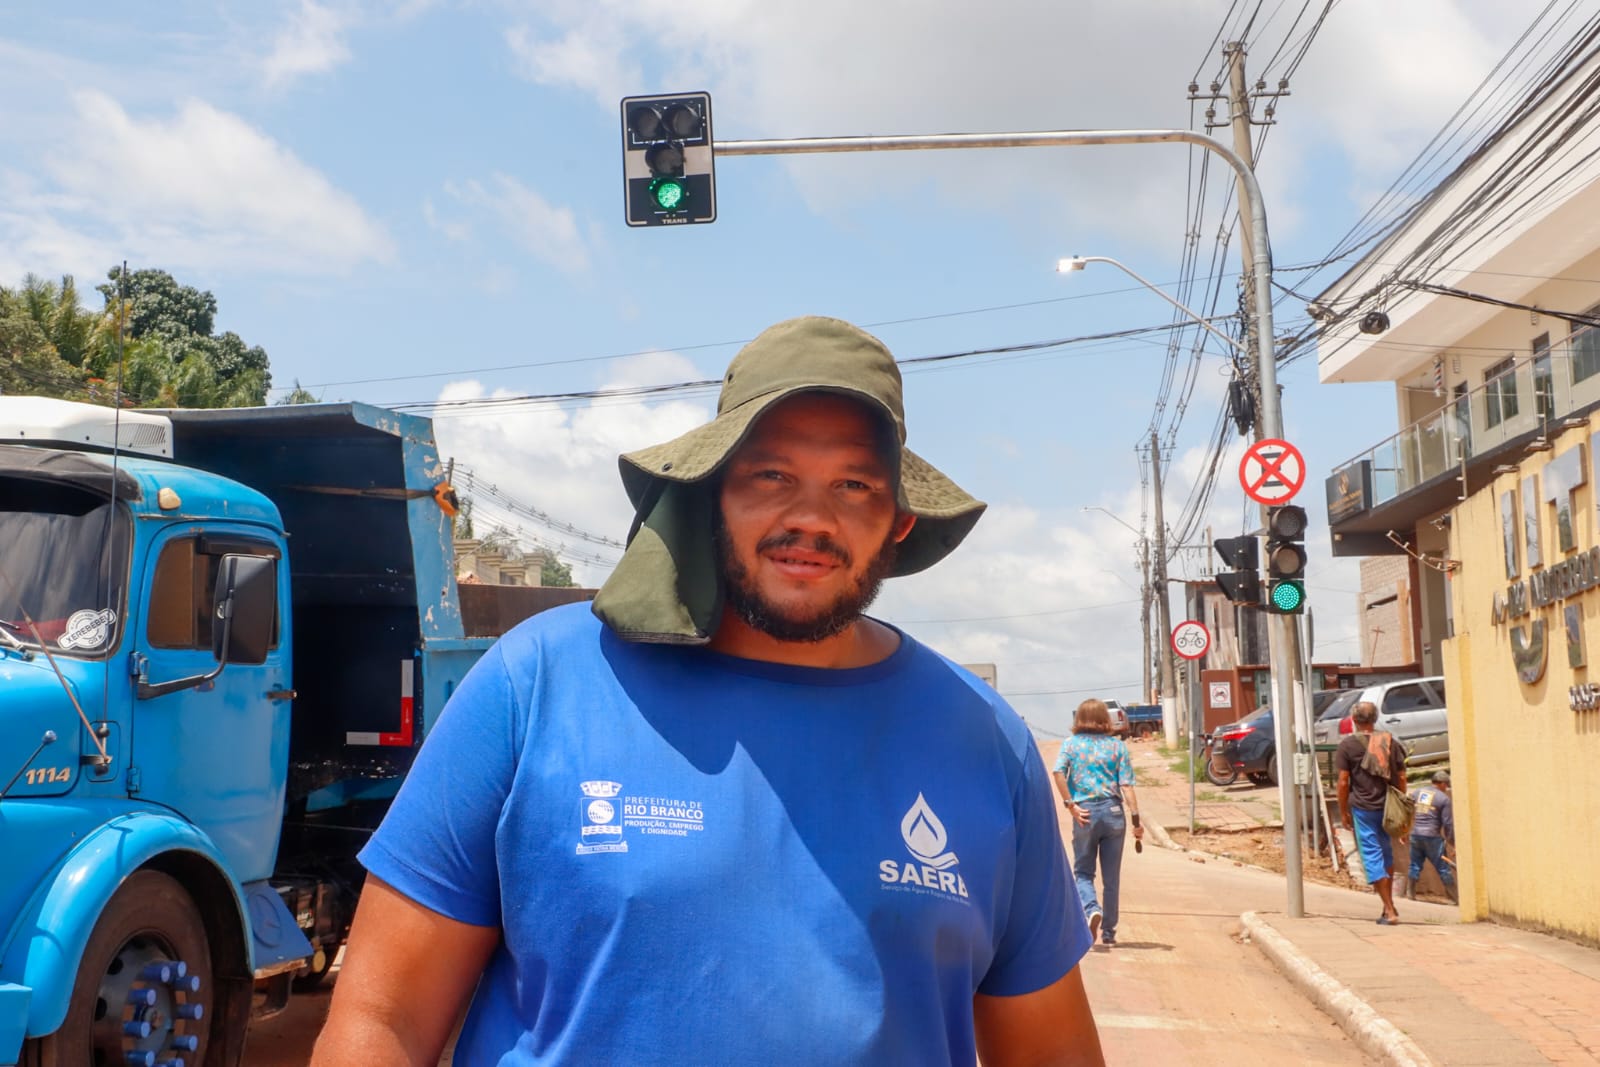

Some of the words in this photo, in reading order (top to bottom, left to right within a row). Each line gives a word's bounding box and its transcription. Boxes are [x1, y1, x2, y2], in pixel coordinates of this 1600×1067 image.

[26, 767, 70, 785] 1114
[625, 796, 687, 807] PREFEITURA
[689, 801, 703, 810] DE
[624, 804, 647, 815] RIO
[650, 805, 704, 820] BRANCO
[647, 828, 688, 836] DIGNIDADE
[668, 821, 704, 831] EMPREGO
